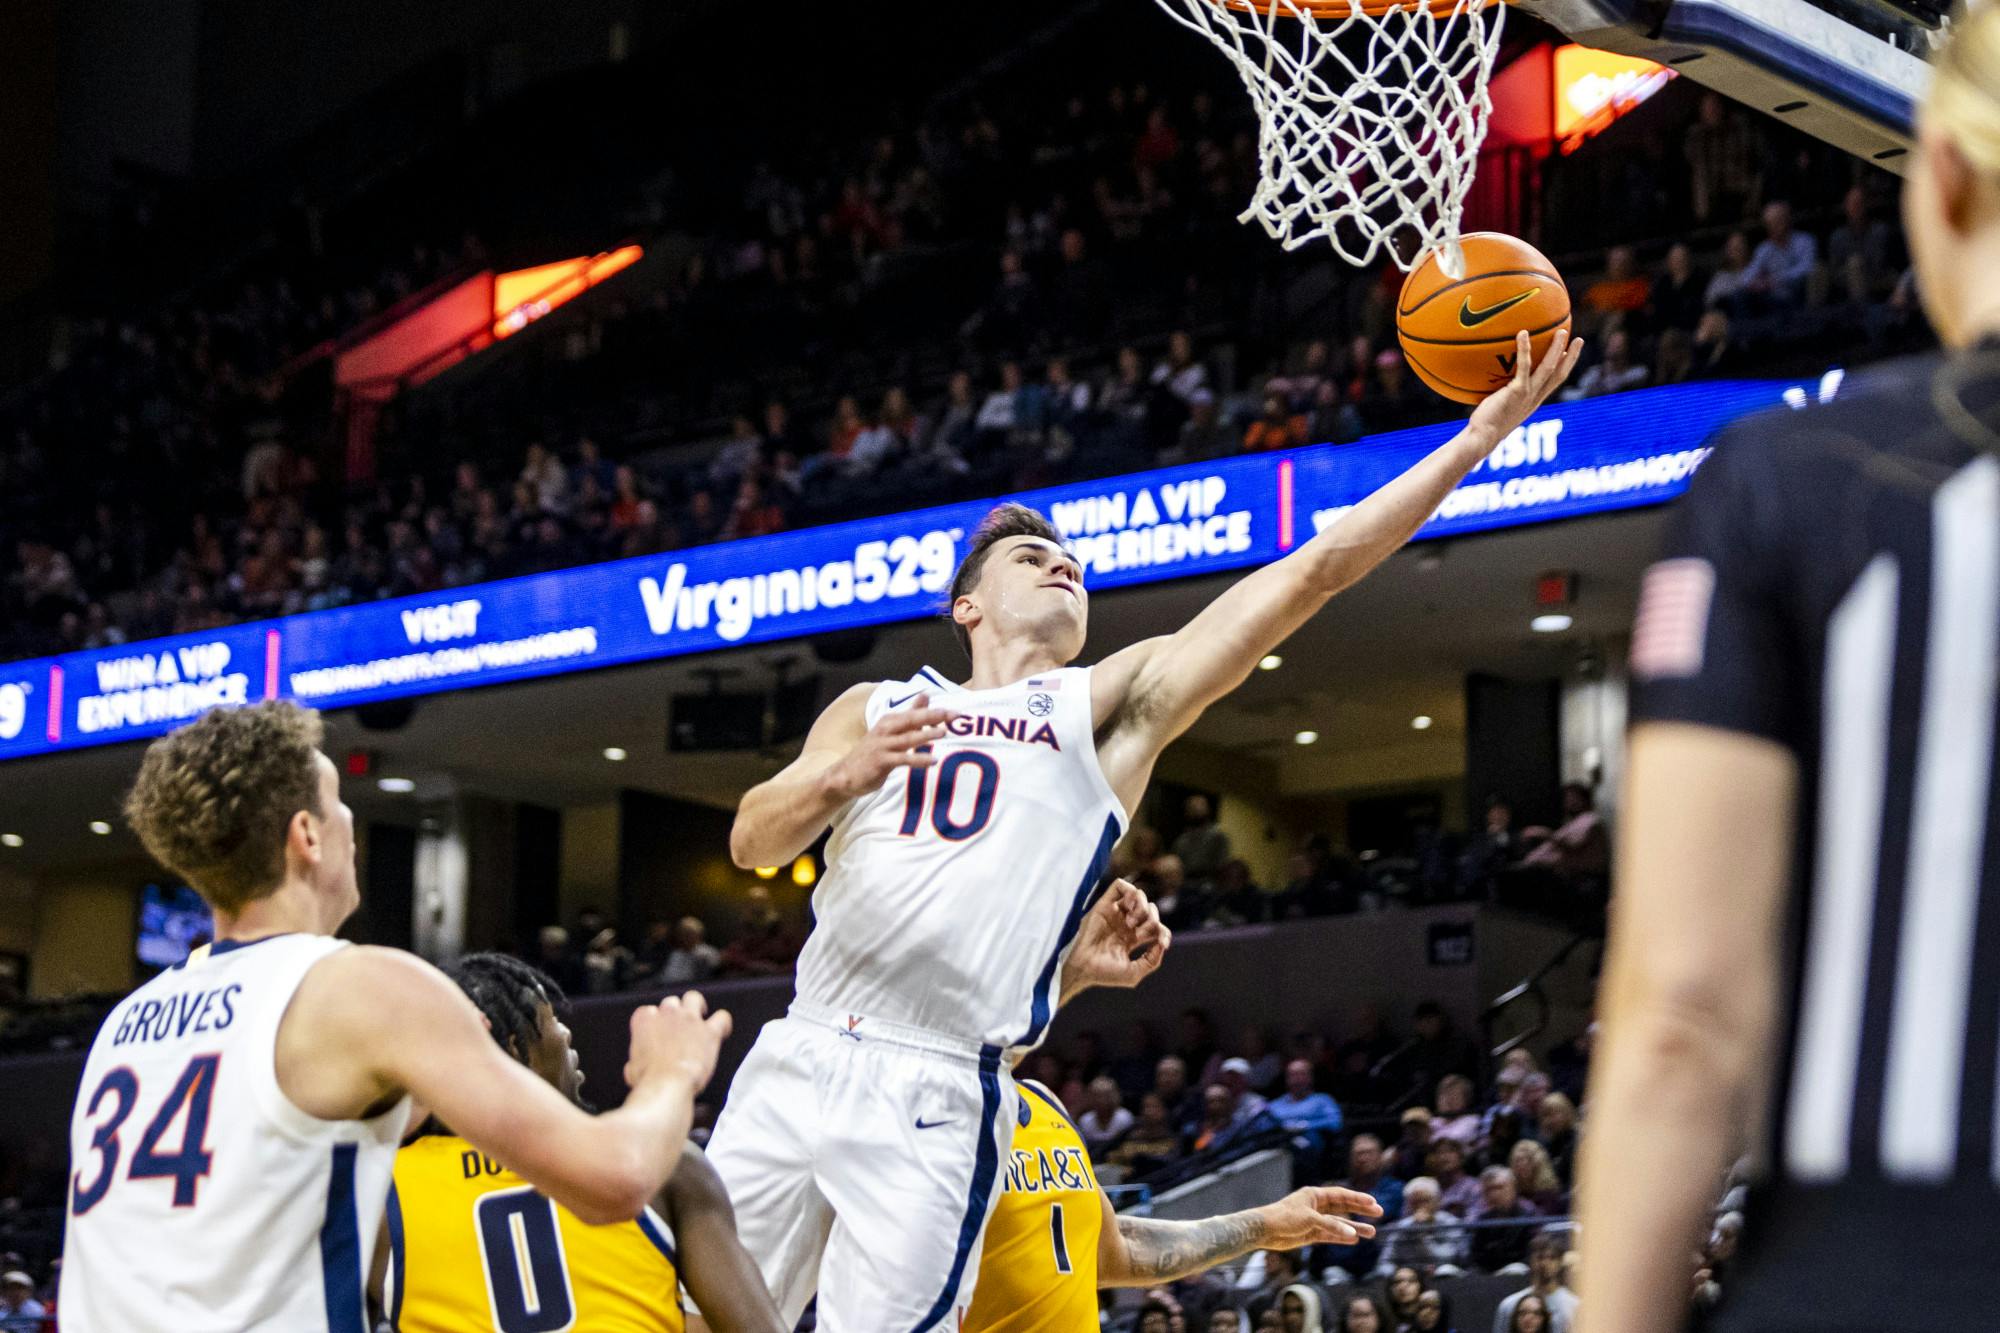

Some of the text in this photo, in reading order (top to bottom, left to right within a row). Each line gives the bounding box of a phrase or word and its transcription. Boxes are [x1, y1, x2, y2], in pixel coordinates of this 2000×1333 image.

[1472, 419, 1563, 472] ISIT
[1052, 476, 1226, 535] WIN A VIP
[1068, 511, 1251, 572] PERIENCE
[639, 530, 955, 642] Virginia529
[945, 714, 1062, 752] GINIA
[897, 743, 1000, 842] 10
[113, 983, 242, 1046] GROVES
[72, 1051, 223, 1217] 34
[473, 1184, 577, 1333] 0
[1051, 1202, 1073, 1274] 1
